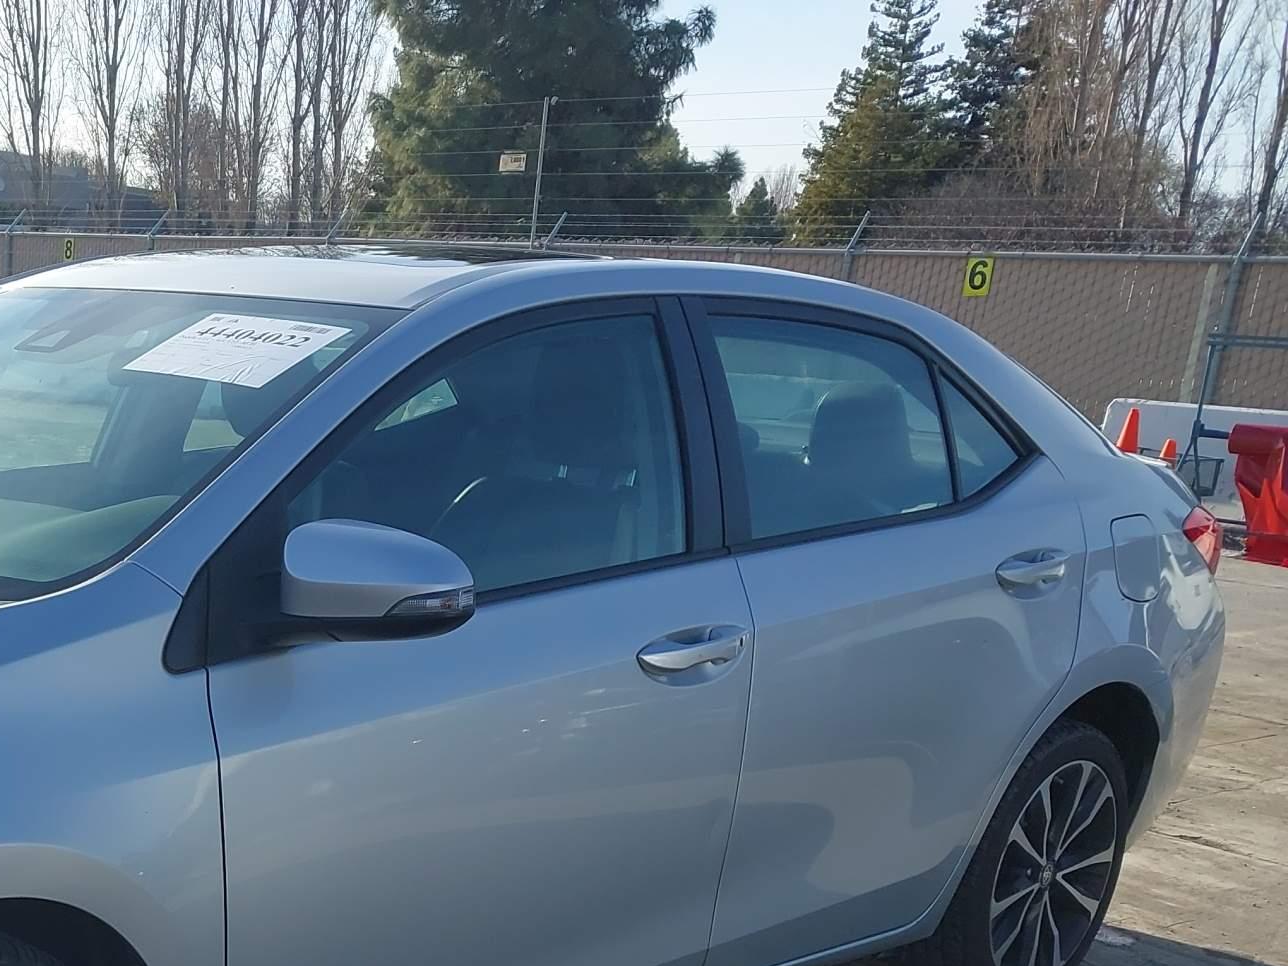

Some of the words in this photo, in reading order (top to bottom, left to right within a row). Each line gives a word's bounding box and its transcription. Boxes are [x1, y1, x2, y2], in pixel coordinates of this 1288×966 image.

[64, 239, 73, 260] 8
[968, 259, 989, 291] 6
[196, 326, 312, 348] 44404022
